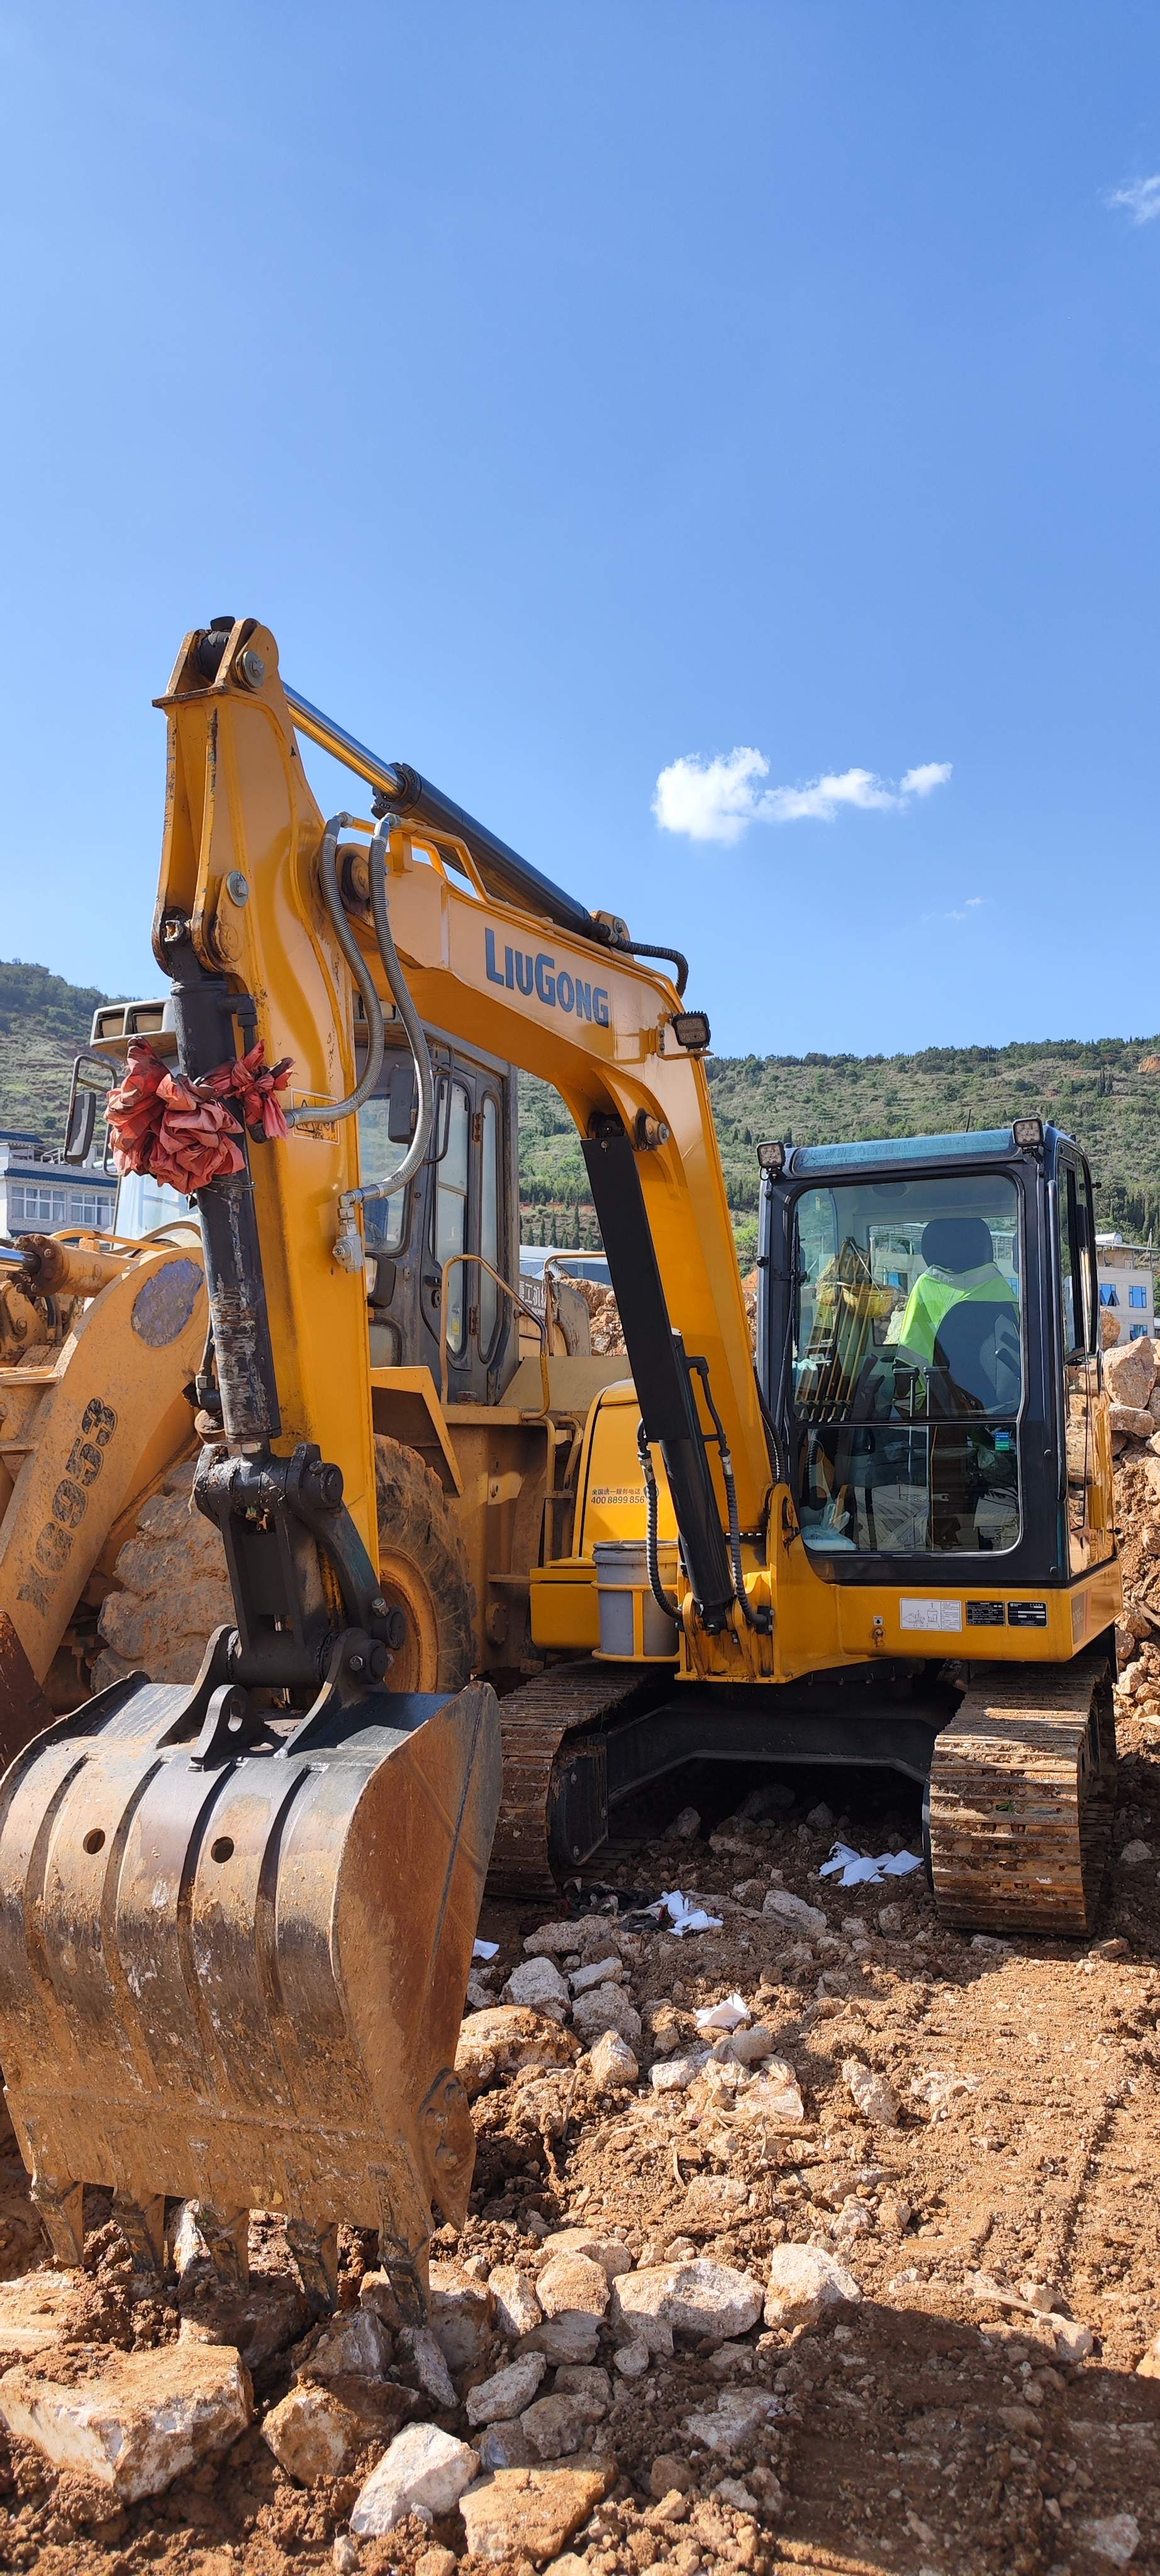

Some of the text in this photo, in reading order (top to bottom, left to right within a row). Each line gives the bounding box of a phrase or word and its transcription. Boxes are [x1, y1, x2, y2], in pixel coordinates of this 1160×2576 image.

[16, 1396, 118, 1618] XG953
[591, 1496, 606, 1504] 400
[629, 1496, 645, 1504] 856
